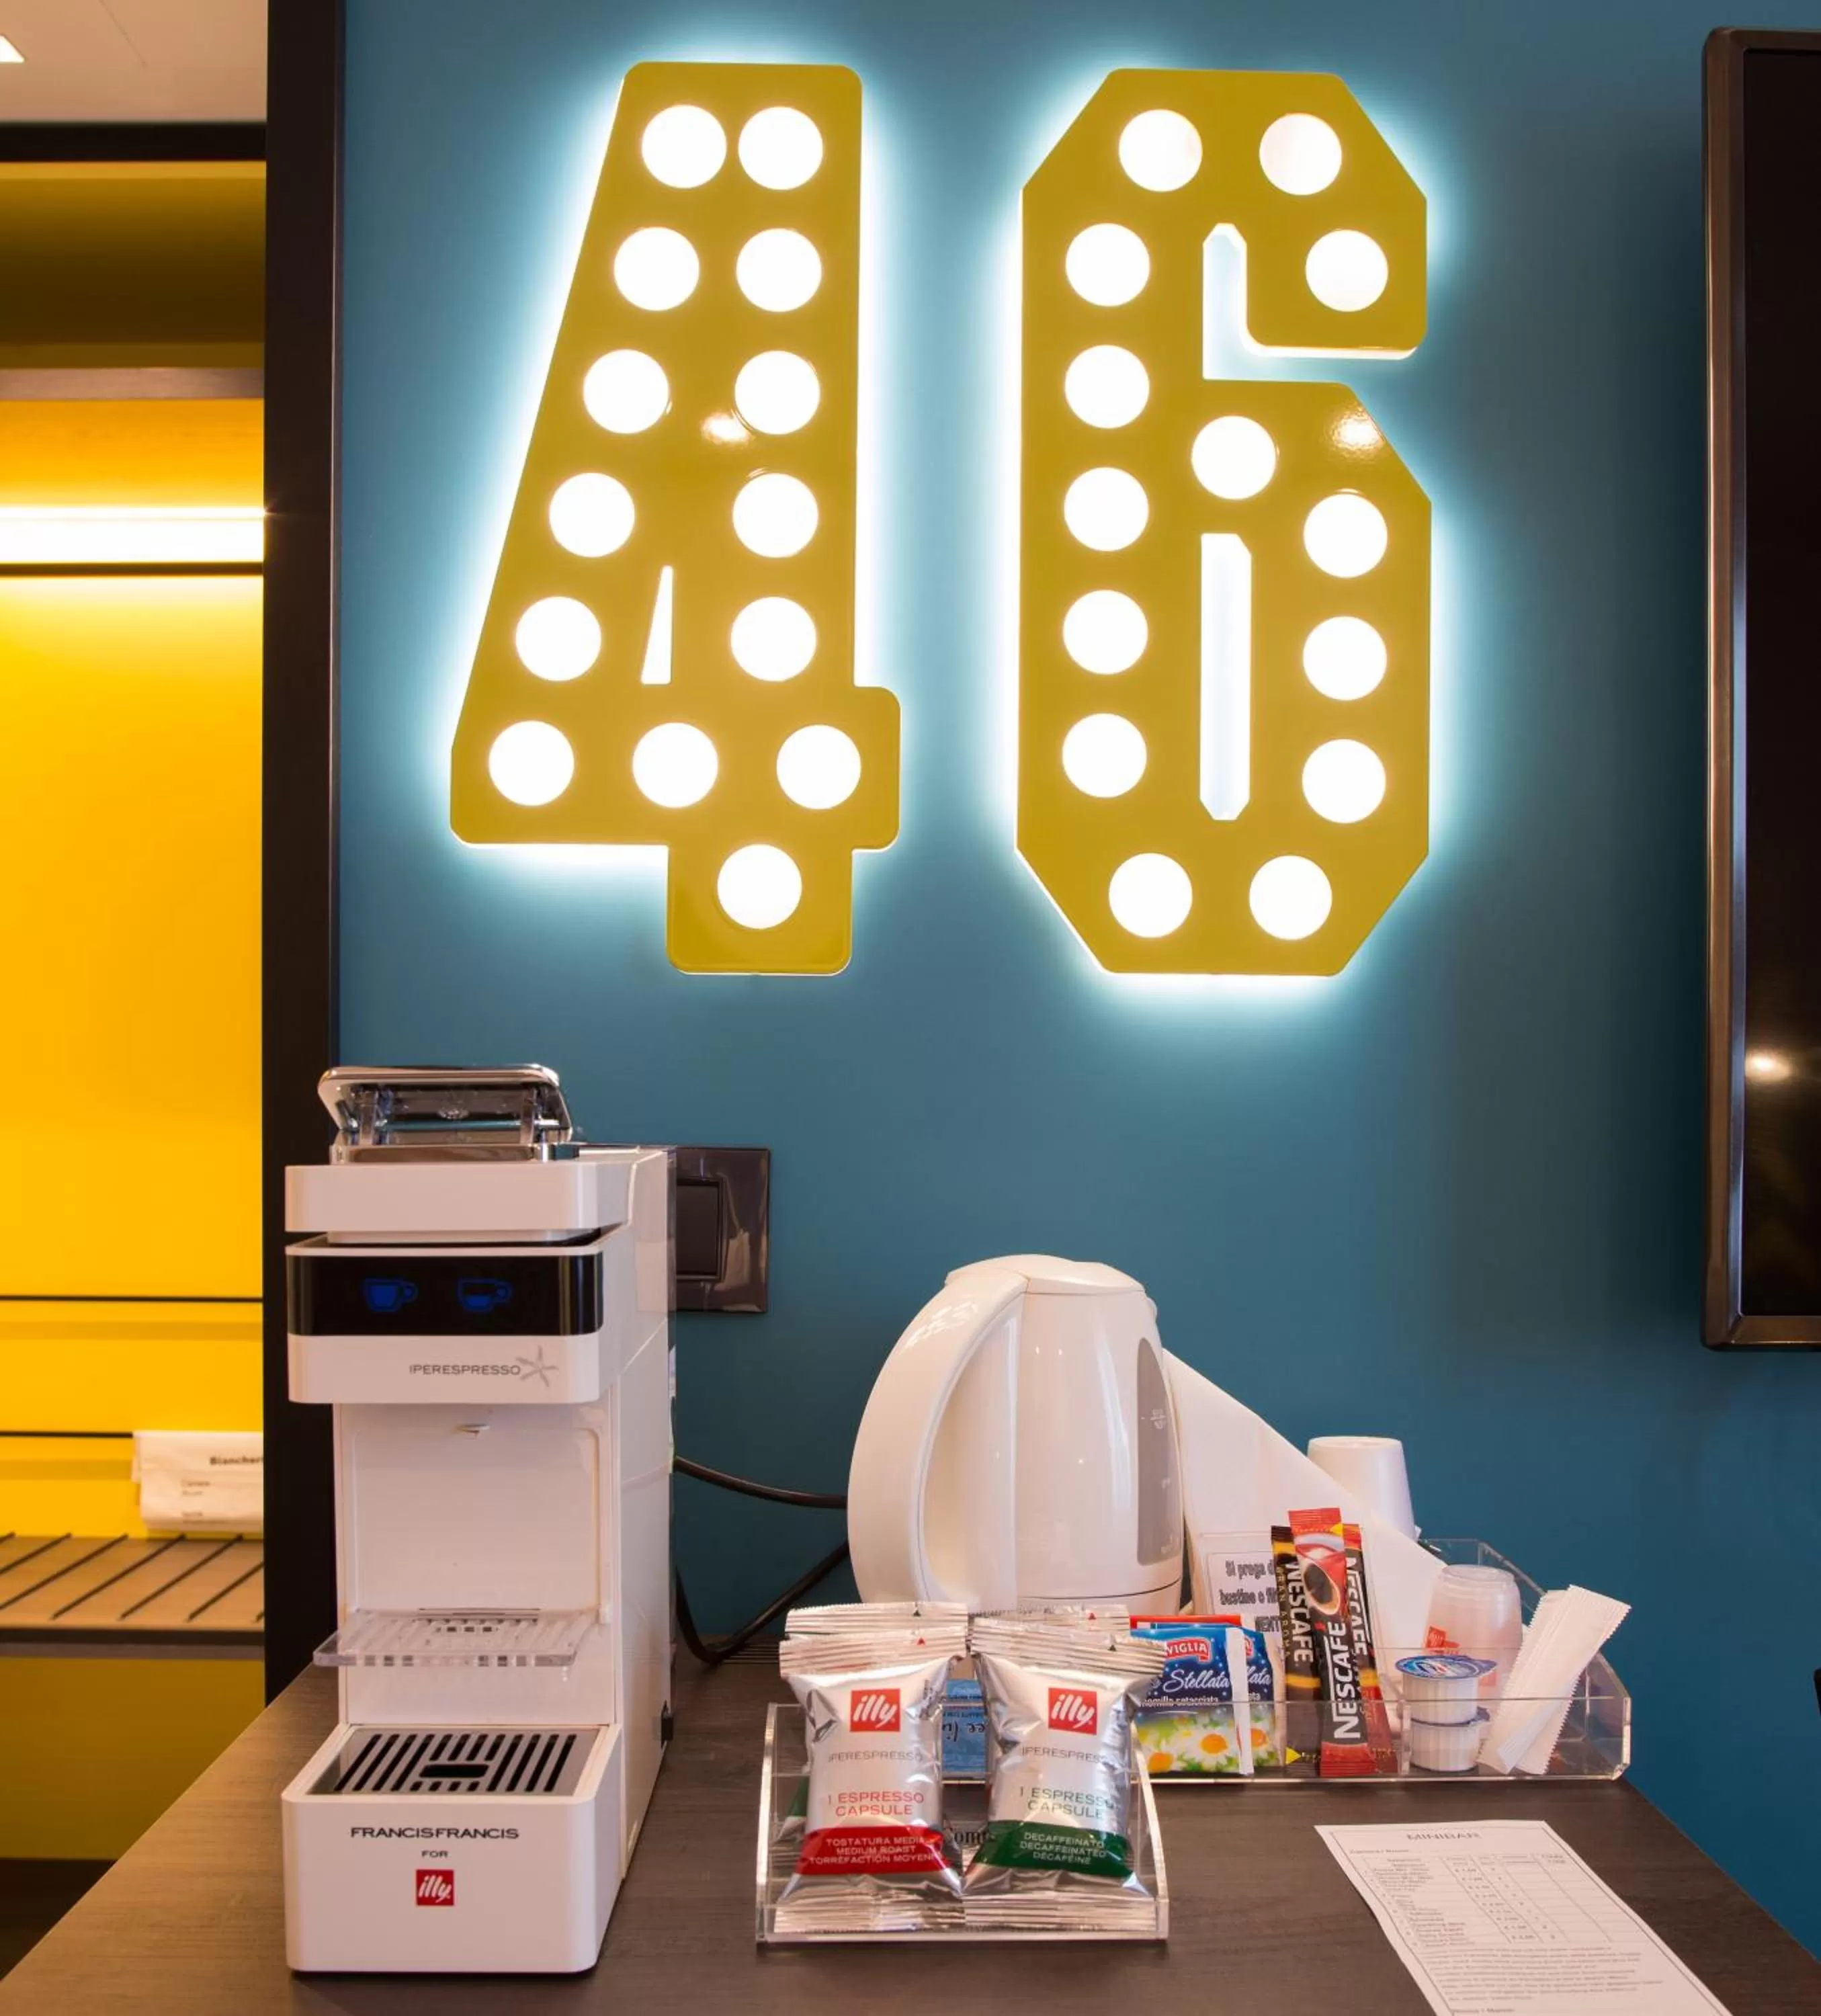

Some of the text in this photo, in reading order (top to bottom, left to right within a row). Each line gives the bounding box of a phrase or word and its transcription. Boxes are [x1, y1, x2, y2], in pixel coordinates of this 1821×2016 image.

[450, 61, 1431, 975] 46
[409, 1364, 521, 1376] IPERESPRESSO
[1162, 1669, 1230, 1693] Stellata
[853, 1693, 898, 1730] illy
[1051, 1693, 1095, 1729] illy
[838, 1791, 925, 1804] ESPRESSO
[835, 1804, 914, 1817] CAPSULE
[351, 1826, 519, 1839] FRANCISFRANCIS
[1023, 1831, 1105, 1849] DECAFFEINATO
[826, 1837, 890, 1847] TOSTATURA
[1019, 1840, 1107, 1859] DECAFFEINATED
[421, 1850, 449, 1858] FOR
[837, 1845, 917, 1855] MEDIUM ROAST
[418, 1874, 452, 1904] illy
